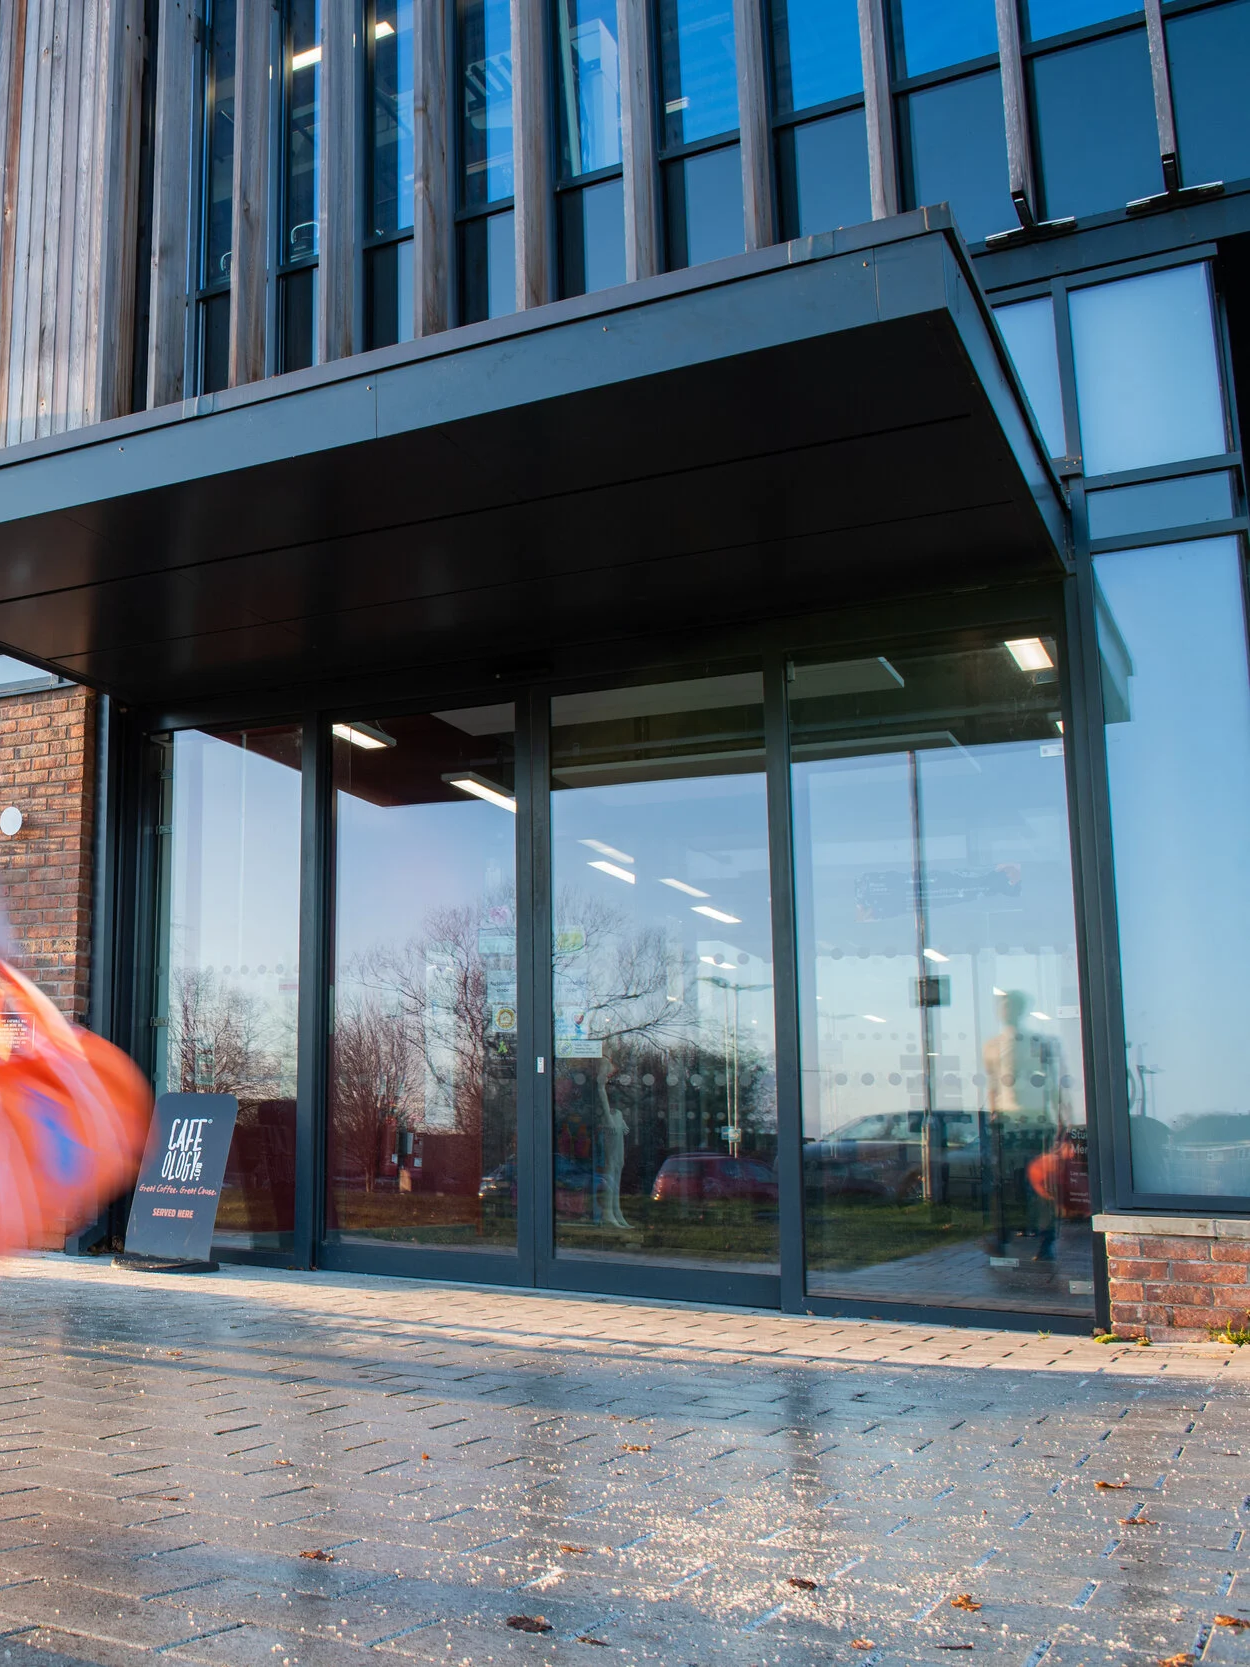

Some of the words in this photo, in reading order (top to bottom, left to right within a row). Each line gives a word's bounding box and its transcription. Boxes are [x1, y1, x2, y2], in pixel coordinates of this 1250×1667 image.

[168, 1118, 208, 1151] CAFE
[161, 1150, 201, 1182] OLOGY
[139, 1183, 156, 1193] Great
[156, 1183, 178, 1195] Coffee.
[179, 1185, 196, 1195] Great
[152, 1207, 176, 1218] SERVED
[177, 1209, 194, 1219] HERE
